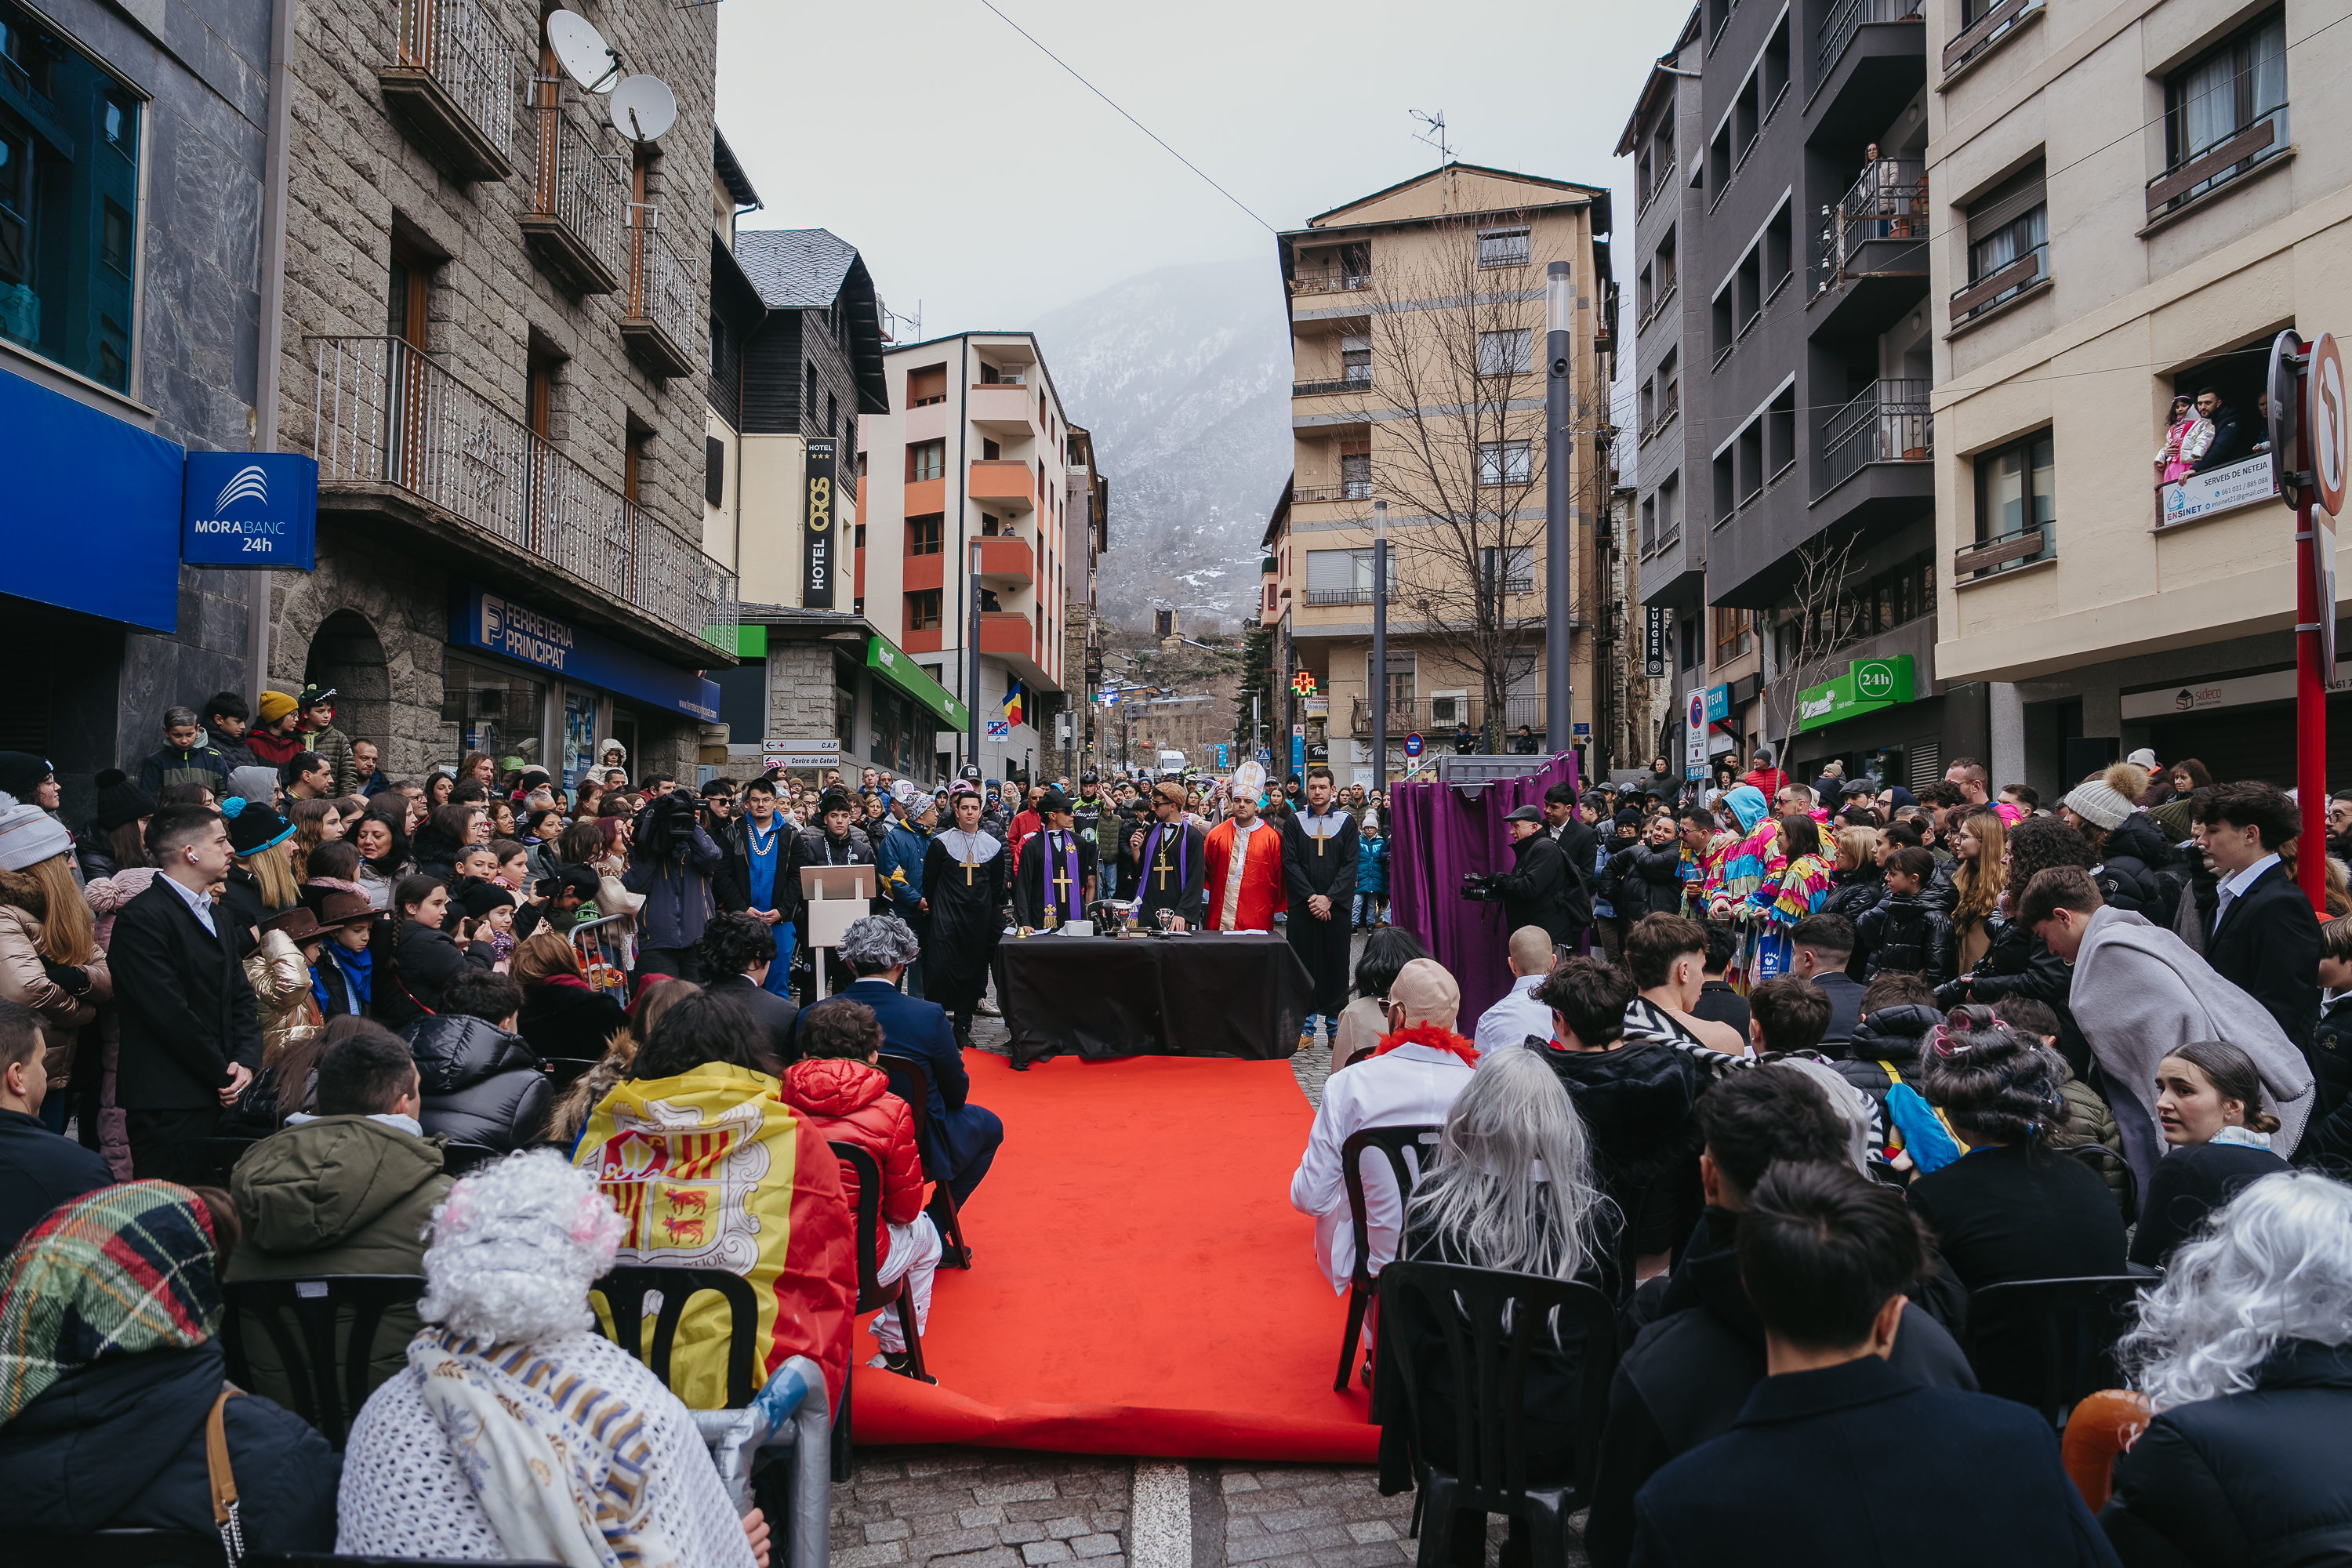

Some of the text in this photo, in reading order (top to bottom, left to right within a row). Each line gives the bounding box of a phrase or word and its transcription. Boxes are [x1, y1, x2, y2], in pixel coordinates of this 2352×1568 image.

[2204, 461, 2268, 487] SERVEIS DE NETEJA
[2258, 477, 2269, 485] 088
[2211, 487, 2269, 508] ensinet21@gmail.com
[2167, 504, 2202, 521] ENSINET
[195, 520, 285, 535] MORABANC
[242, 538, 272, 552] 24h
[812, 539, 825, 590] HOTEL
[506, 601, 573, 649] FERRETERIA
[506, 628, 565, 670] PRINCIPAT
[1862, 673, 1889, 685] 24h
[2195, 687, 2222, 701] sideco
[683, 1251, 728, 1267] TIOR
